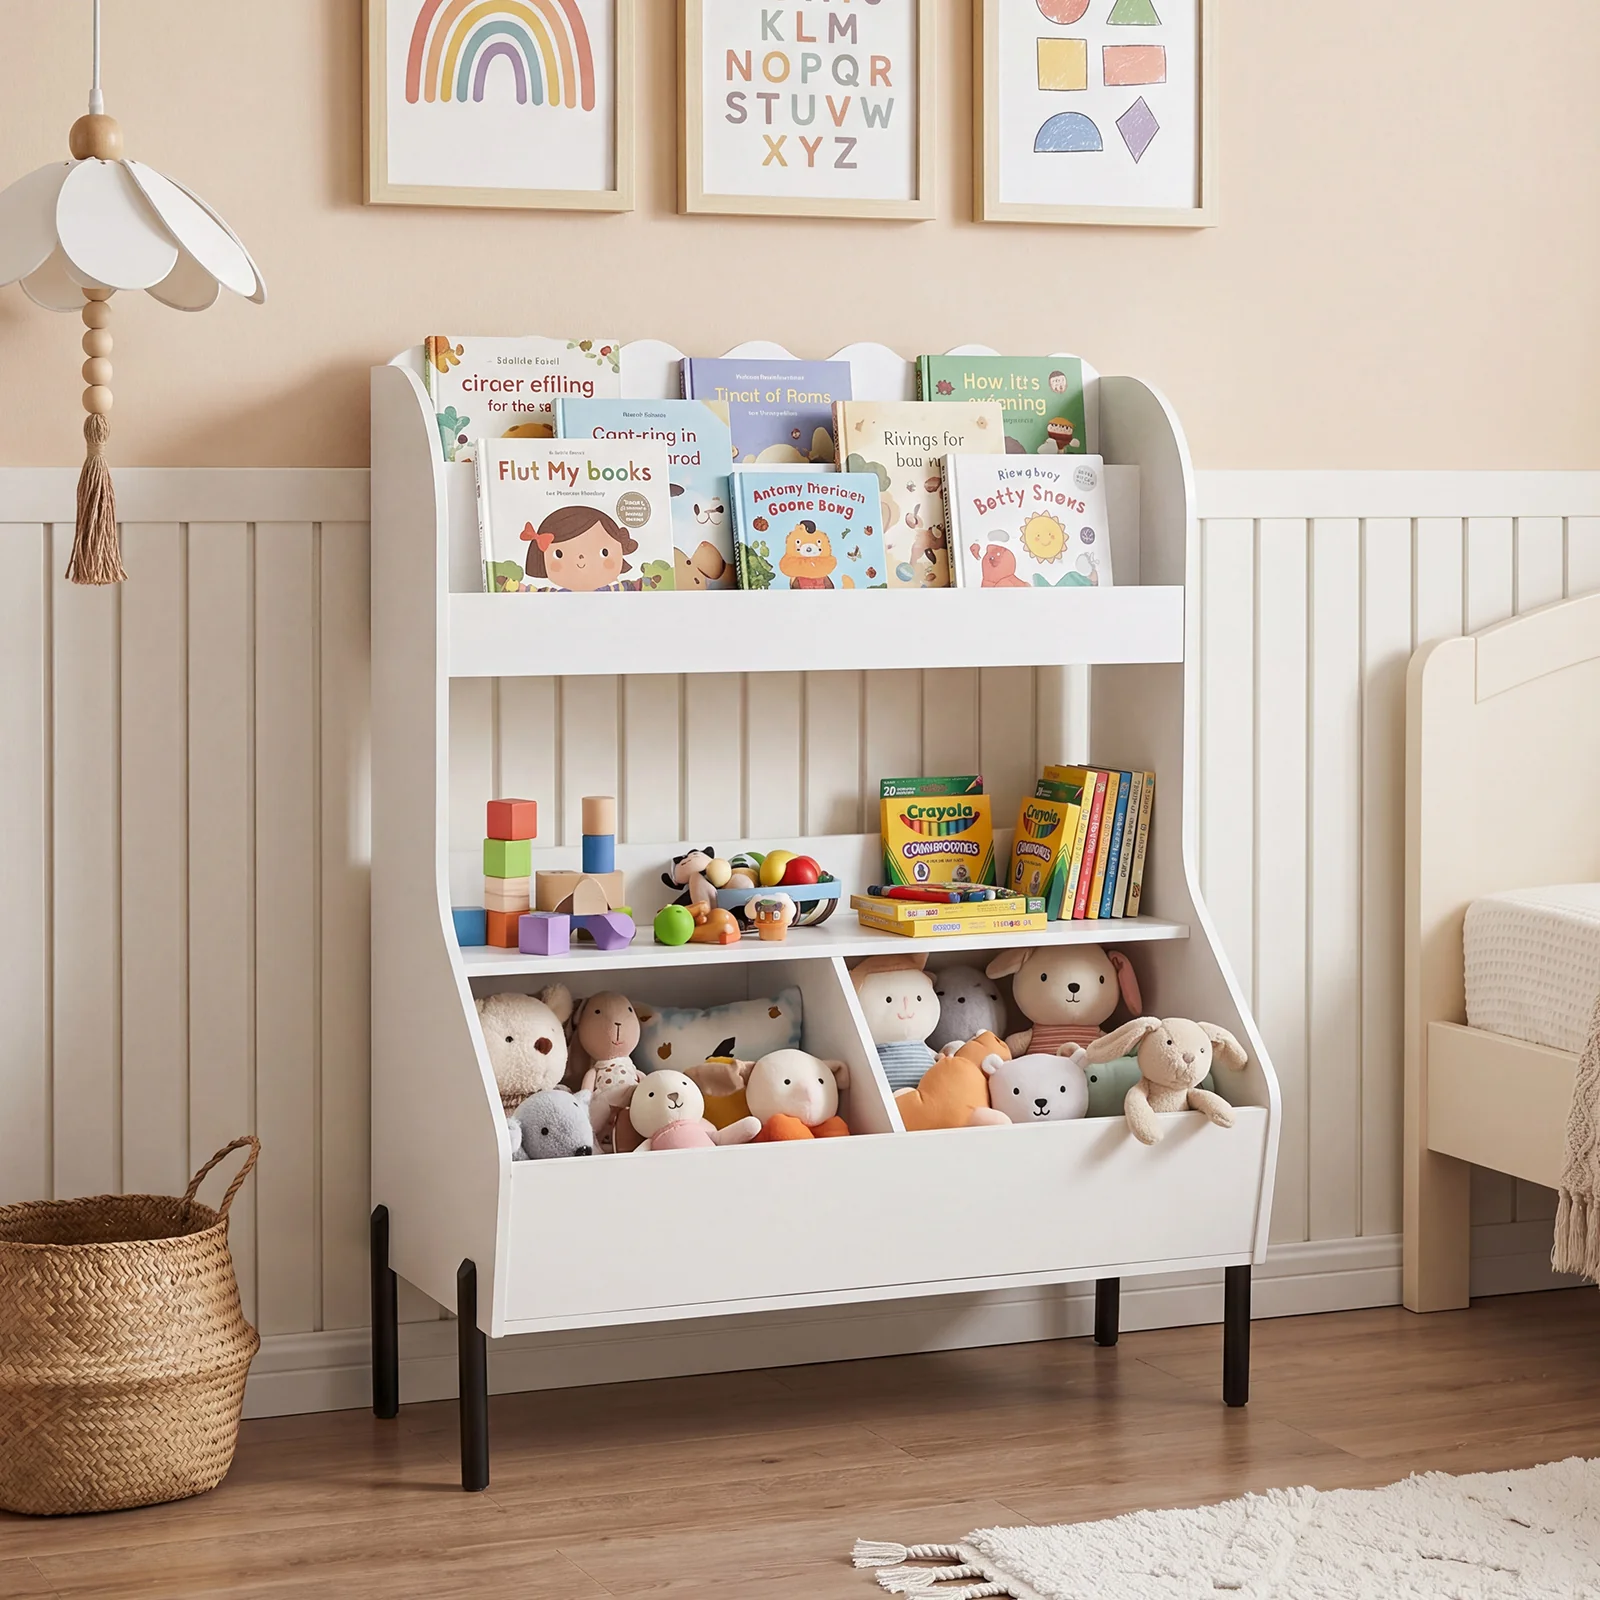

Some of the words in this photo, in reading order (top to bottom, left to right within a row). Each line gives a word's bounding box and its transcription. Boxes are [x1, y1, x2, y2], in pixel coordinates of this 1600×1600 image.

[765, 387, 781, 403] of
[787, 389, 832, 404] Roms
[488, 399, 508, 412] for
[511, 399, 535, 412] the
[681, 427, 697, 442] in
[884, 430, 938, 451] Rivings
[943, 430, 965, 446] for
[498, 460, 540, 481] Flut
[547, 460, 580, 487] My
[587, 459, 652, 482] books
[753, 484, 803, 504] Antomy
[768, 500, 814, 516] Goone
[883, 785, 896, 797] 20
[906, 802, 973, 821] Crayola
